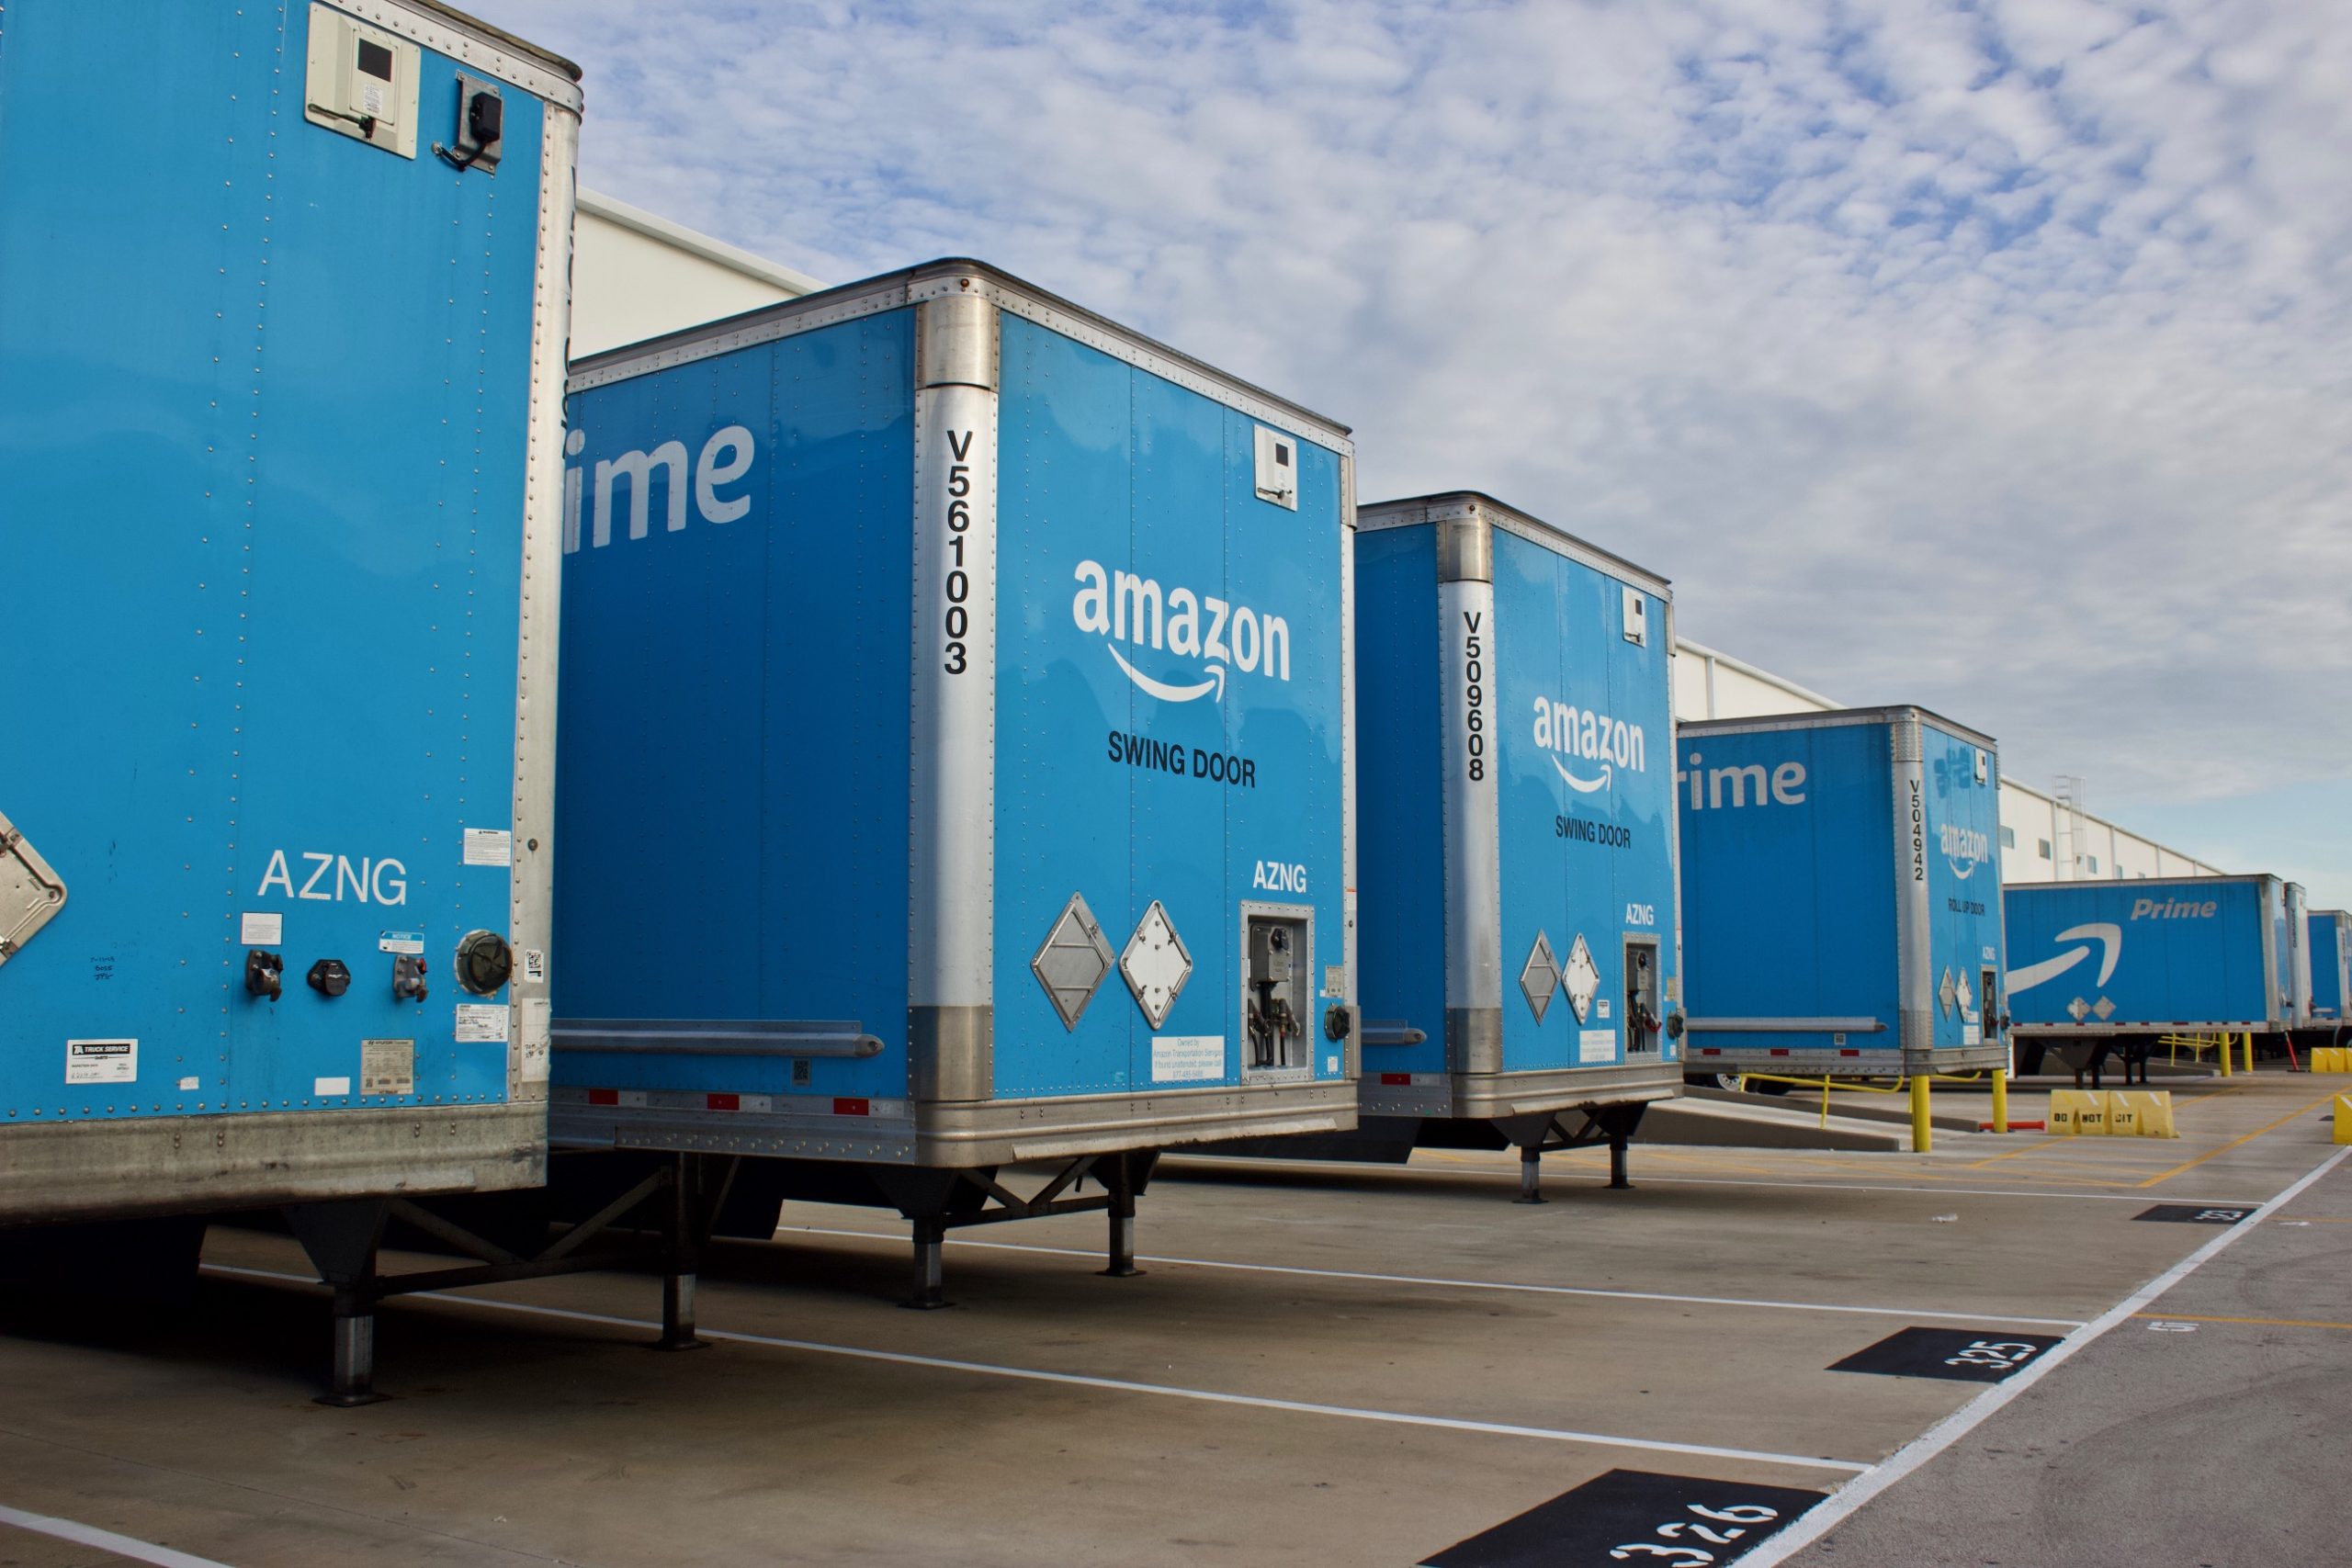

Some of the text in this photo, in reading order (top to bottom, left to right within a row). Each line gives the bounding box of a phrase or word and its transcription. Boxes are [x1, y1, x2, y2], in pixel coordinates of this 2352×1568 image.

[563, 425, 754, 555] ime
[944, 430, 974, 674] V561003
[1072, 559, 1290, 682] amazon
[1464, 611, 1485, 782] V509608
[1533, 695, 1645, 773] amazon
[1108, 731, 1256, 788] SWING DOOR
[1555, 815, 1631, 849] SWING DOOR
[1910, 780, 1923, 881] V504942
[1940, 821, 1988, 864] amazon
[258, 850, 406, 906] AZNG
[1253, 860, 1306, 893] AZNG
[1625, 903, 1654, 926] AZNG
[1949, 897, 1984, 917] ROLL UP DOOR
[2131, 897, 2217, 921] Prime
[1178, 1038, 1200, 1047] Owned by
[2054, 1112, 2067, 1122] DO
[2082, 1113, 2102, 1123] NOT
[1944, 1340, 2037, 1369] 325
[1610, 1504, 1779, 1568] 326
